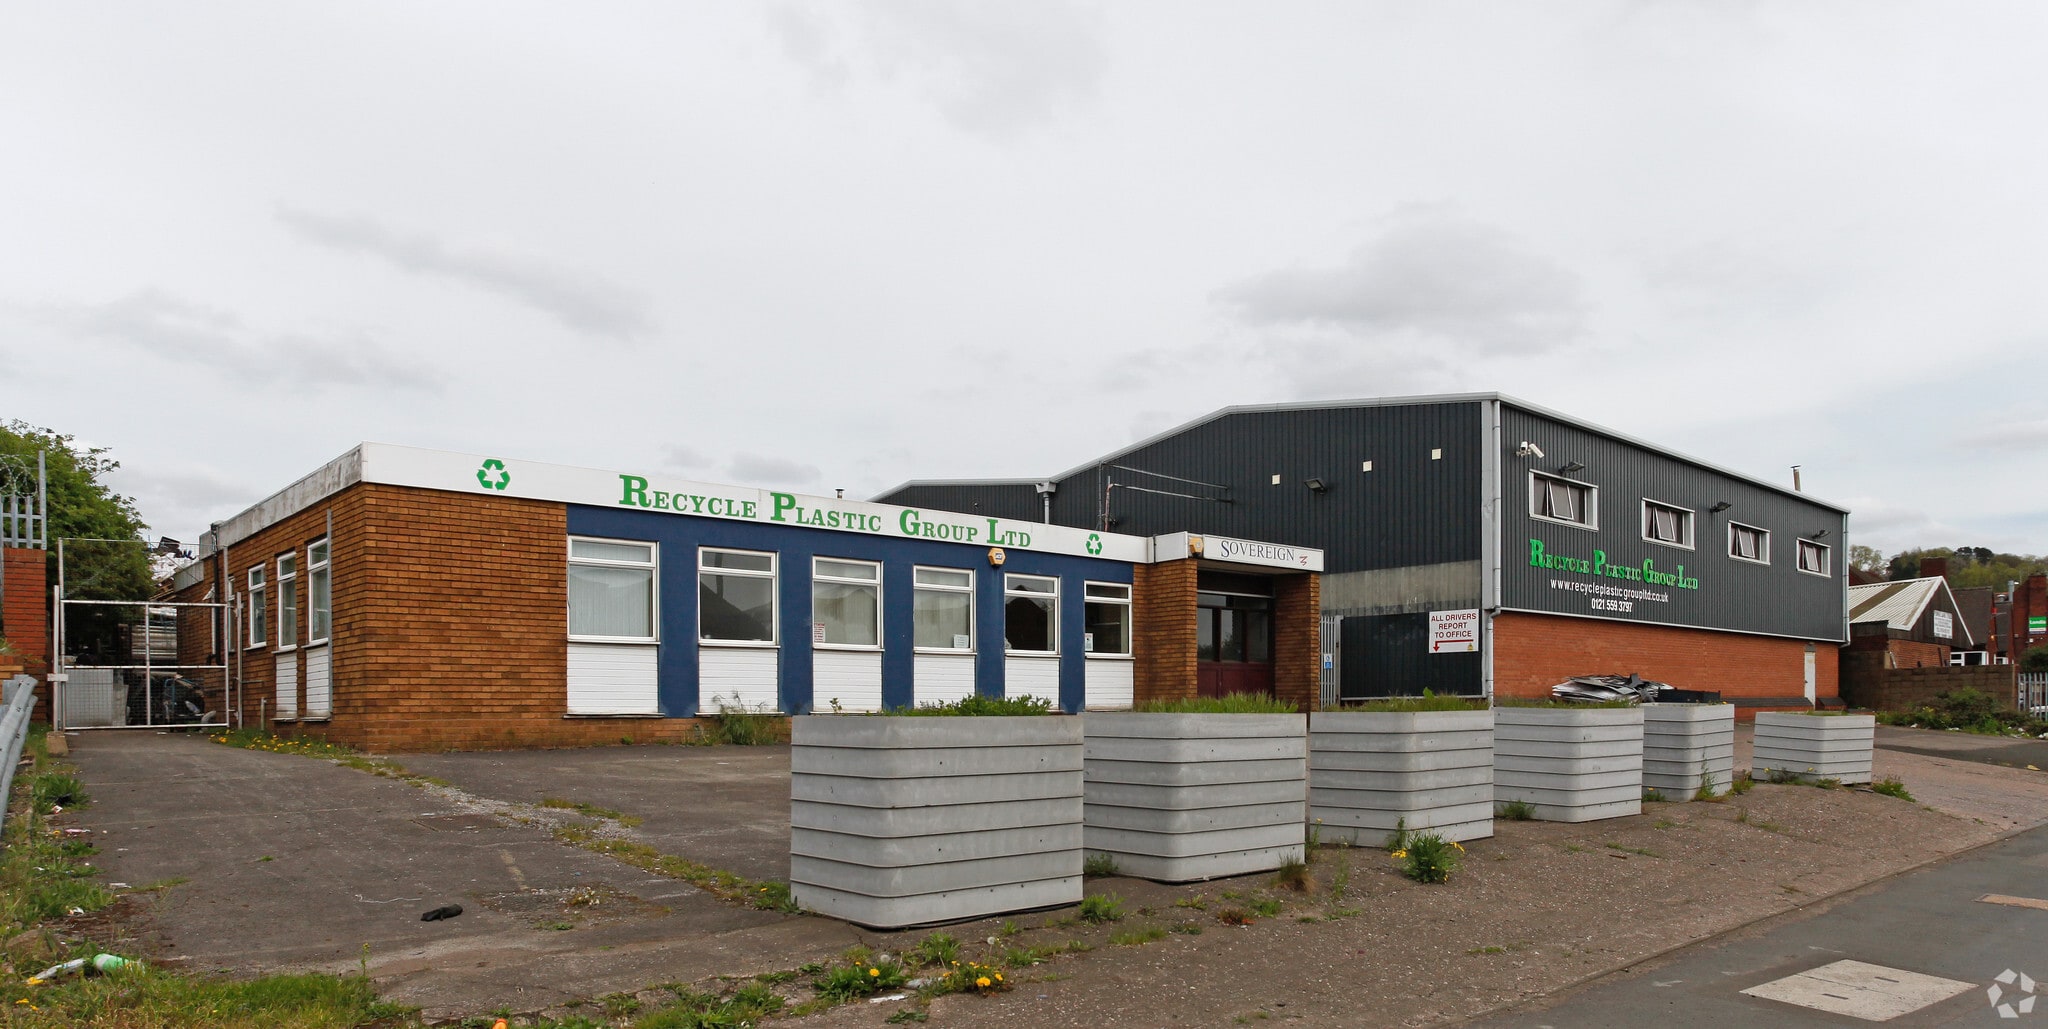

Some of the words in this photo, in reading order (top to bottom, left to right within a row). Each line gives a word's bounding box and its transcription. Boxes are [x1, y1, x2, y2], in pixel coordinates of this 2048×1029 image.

[618, 474, 757, 519] RECYCLE
[769, 492, 882, 532] PLASTIC
[899, 509, 978, 542] GROUP
[986, 518, 1031, 547] LTD
[1221, 540, 1295, 561] SOVEREIGN
[1529, 538, 1590, 573] RECYCLE
[1593, 549, 1641, 581] PLASTIC
[1643, 558, 1676, 586] GROUP
[1677, 565, 1699, 590] LTD
[1591, 598, 1605, 610] 0121
[1606, 599, 1618, 611] 559
[1618, 601, 1633, 612] 3797
[1445, 612, 1477, 621] DRIVERS
[1438, 622, 1468, 630] REPORT
[1435, 631, 1445, 639] TO
[1446, 630, 1473, 638] OFFICE
